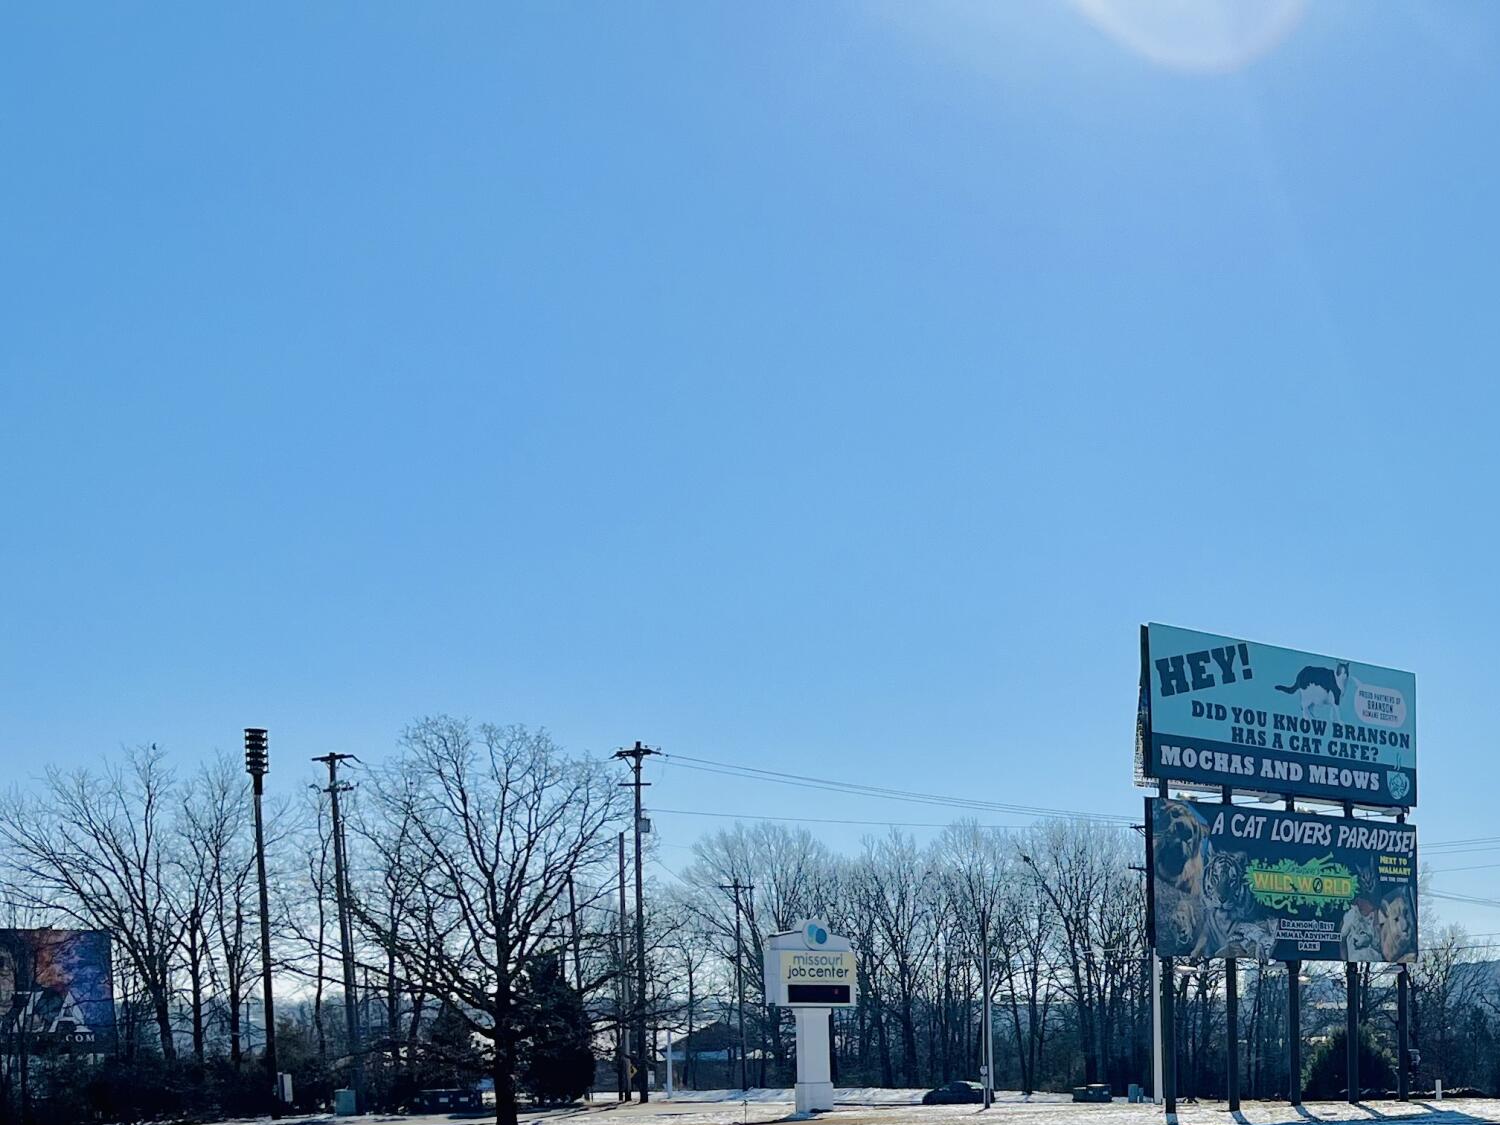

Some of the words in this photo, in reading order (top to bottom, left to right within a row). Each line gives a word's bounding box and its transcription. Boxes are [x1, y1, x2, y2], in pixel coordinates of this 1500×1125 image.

[1155, 643, 1253, 697] HEY!
[1367, 699, 1394, 714] BRANSON
[1192, 700, 1227, 721] DID
[1233, 707, 1267, 728] YOU
[1273, 714, 1327, 737] KNOW
[1332, 722, 1410, 749] BRANSON
[1231, 726, 1266, 747] HAS
[1272, 732, 1284, 749] A
[1286, 734, 1321, 754] CAT
[1328, 740, 1379, 762] CAFE?
[1160, 744, 1255, 776] MOCHAS
[1260, 761, 1303, 782] AND
[1309, 764, 1380, 791] MEOWS
[1211, 812, 1225, 836] A
[1231, 813, 1267, 839] CAT
[1270, 818, 1332, 847] LOVERS
[1337, 825, 1416, 857] PARADISE!
[1378, 865, 1411, 876] WALMART
[1380, 855, 1397, 865] NEXT
[1398, 857, 1408, 866] TO
[1253, 871, 1294, 893] WILD
[1298, 874, 1351, 896] WORLD
[1275, 930, 1302, 940] ANIMAL
[1303, 931, 1342, 942] ADVENTURE
[1319, 921, 1335, 931] BEST
[793, 952, 843, 966] missouri
